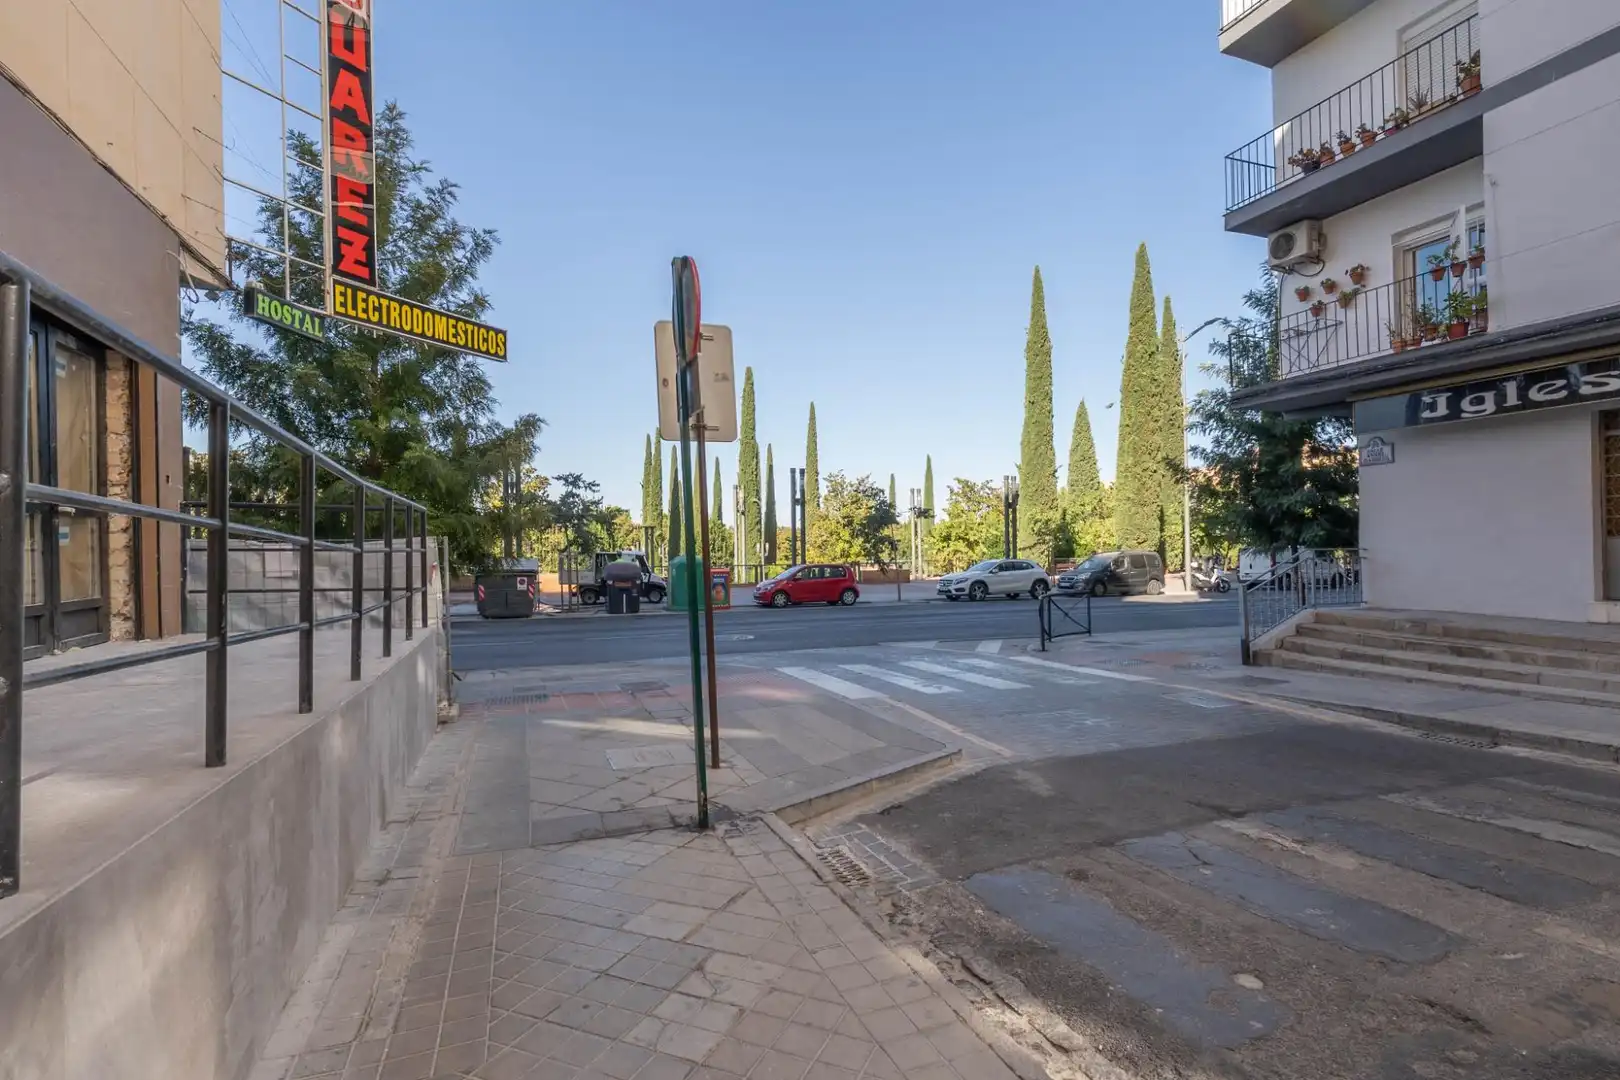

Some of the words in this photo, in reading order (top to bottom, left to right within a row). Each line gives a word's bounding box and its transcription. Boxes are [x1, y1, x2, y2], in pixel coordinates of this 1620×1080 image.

[329, 0, 371, 281] UAREZ
[256, 294, 324, 338] HOSTAL
[334, 284, 506, 357] ELECTRODOMESTICOS
